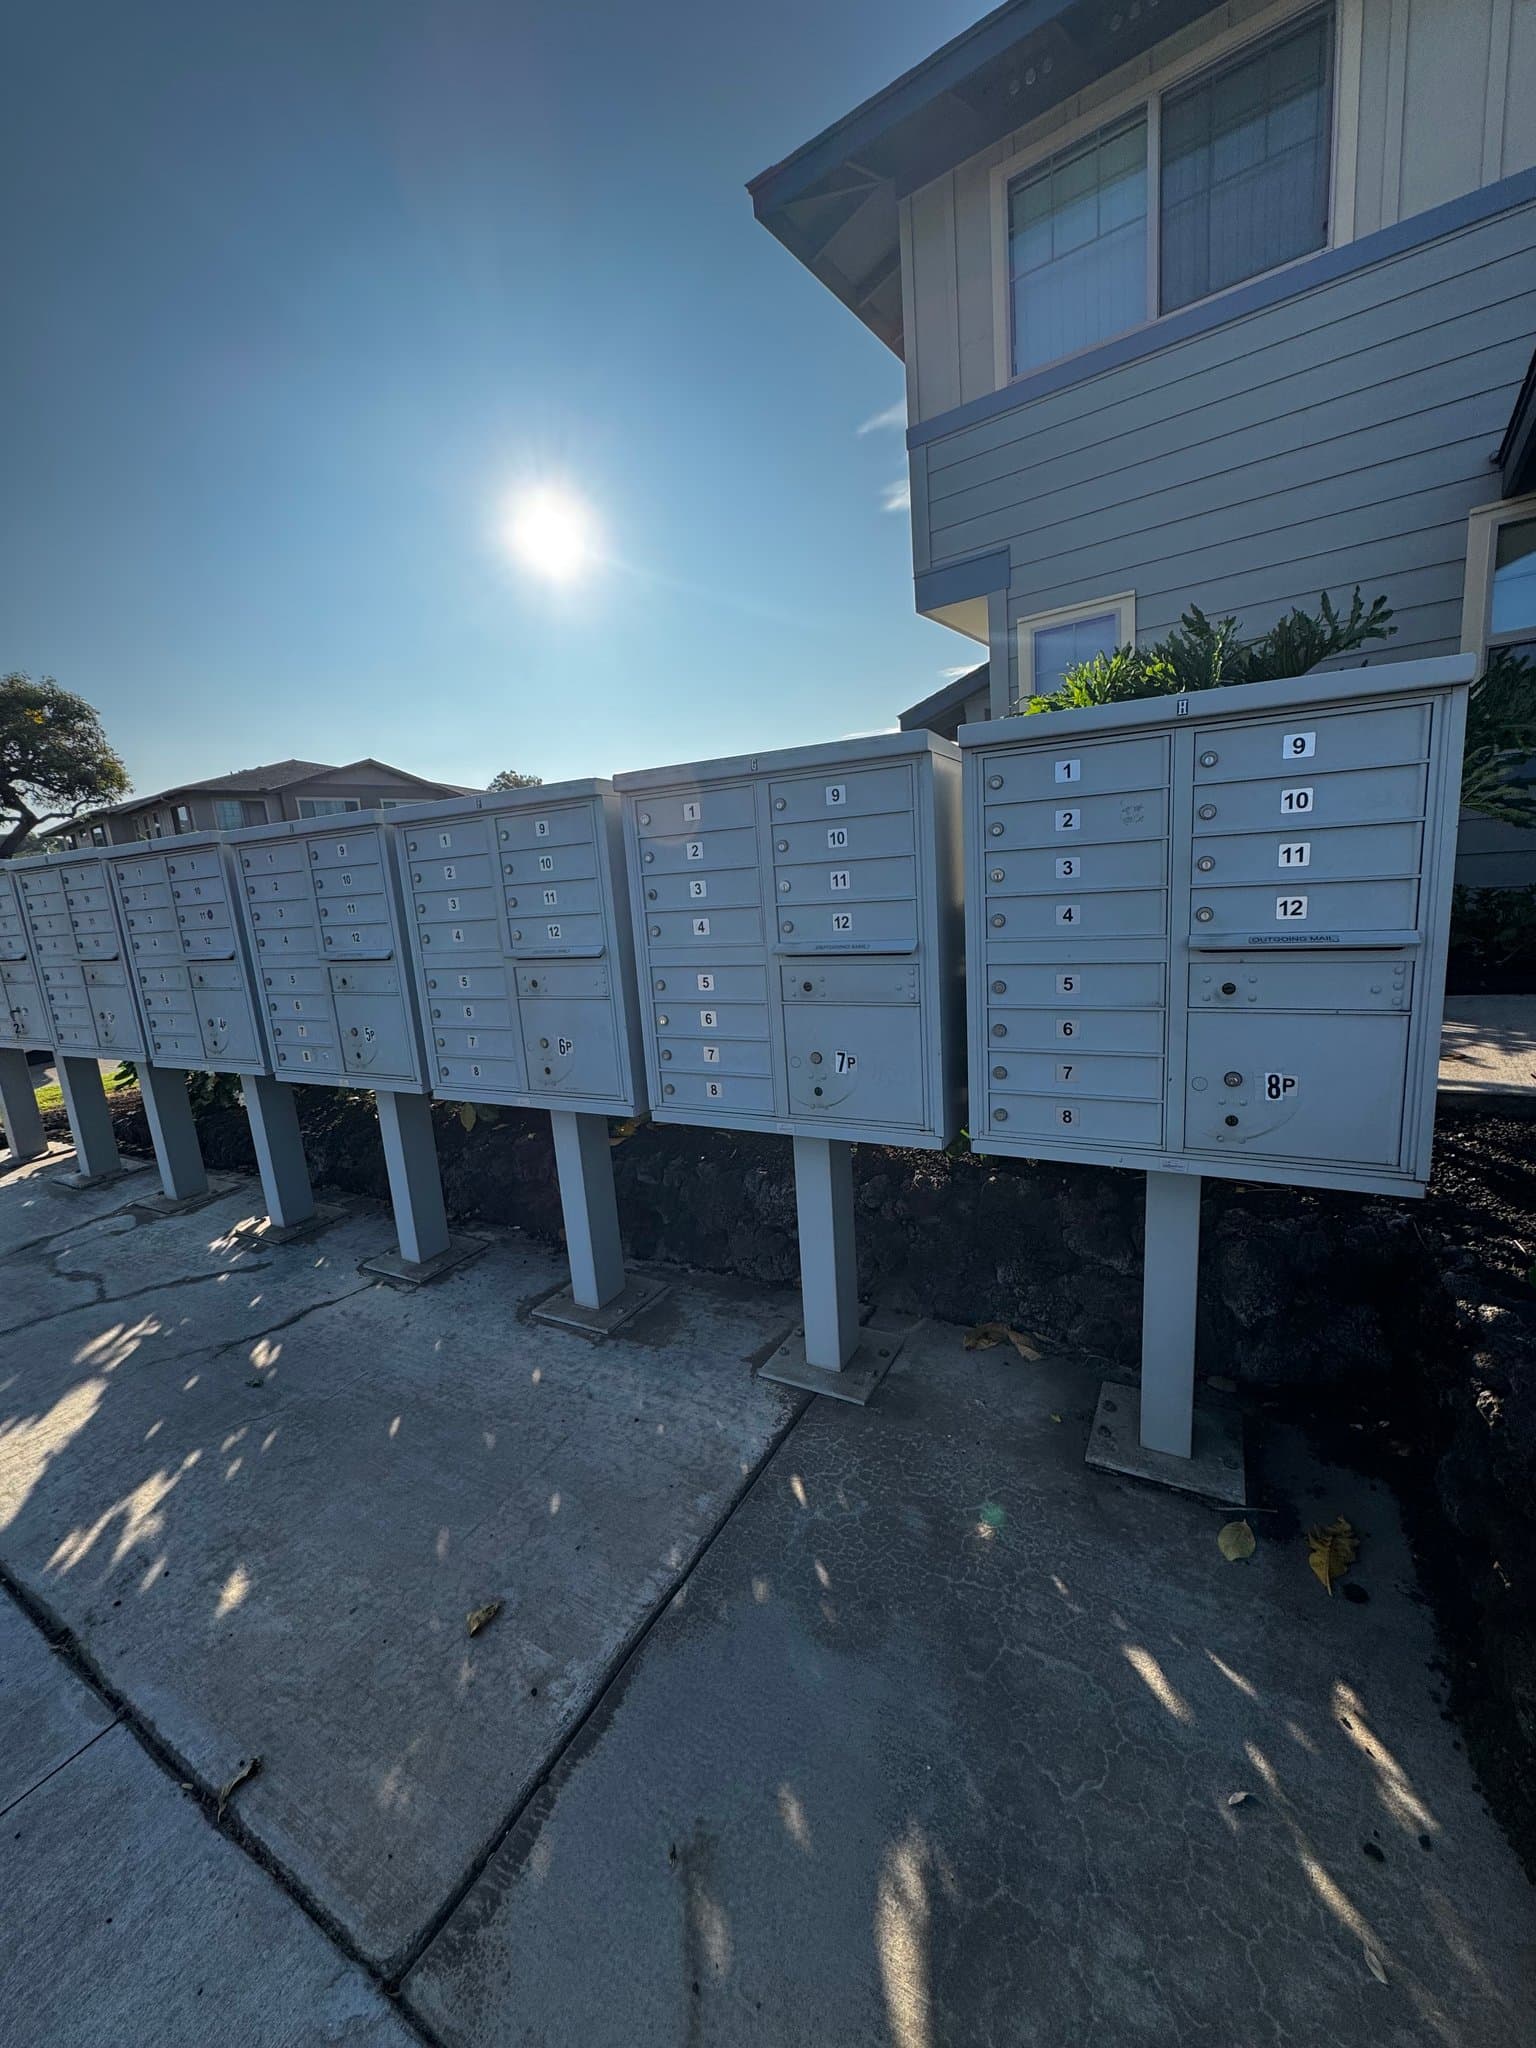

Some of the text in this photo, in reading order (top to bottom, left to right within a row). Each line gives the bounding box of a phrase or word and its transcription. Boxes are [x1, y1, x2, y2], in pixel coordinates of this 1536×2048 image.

[1177, 700, 1188, 715] H
[1293, 737, 1305, 754] 9
[1064, 764, 1070, 778] 1
[832, 789, 839, 802] 9
[1285, 792, 1308, 809] 10
[689, 806, 694, 817] 1
[1063, 813, 1072, 827] 2
[539, 824, 545, 834] 9
[442, 836, 447, 845] 1
[830, 832, 844, 845] 10
[692, 845, 698, 856] 2
[1283, 847, 1304, 863] 11
[541, 858, 551, 869] 10
[1063, 861, 1072, 875] 3
[447, 868, 453, 878] 2
[833, 874, 846, 887] 11
[695, 883, 701, 895] 3
[545, 892, 554, 902] 11
[451, 900, 456, 909] 3
[1279, 900, 1302, 916] 12
[1063, 908, 1073, 922] 4
[698, 921, 705, 932] 4
[835, 916, 849, 928] 12
[456, 931, 460, 940] 4
[549, 926, 559, 936] 12
[462, 977, 467, 986] 5
[703, 977, 709, 988] 5
[1064, 977, 1073, 991] 5
[466, 1008, 471, 1016] 6
[705, 1013, 712, 1024] 6
[1063, 1023, 1072, 1036] 6
[470, 1037, 475, 1046] 7
[559, 1038, 572, 1054] 6P
[708, 1049, 714, 1060] 7
[837, 1052, 855, 1072] 7P
[474, 1067, 479, 1076] 8
[1064, 1066, 1072, 1079] 7
[711, 1085, 717, 1095] 8
[1268, 1074, 1295, 1099] 8P
[1063, 1110, 1072, 1123] 8
